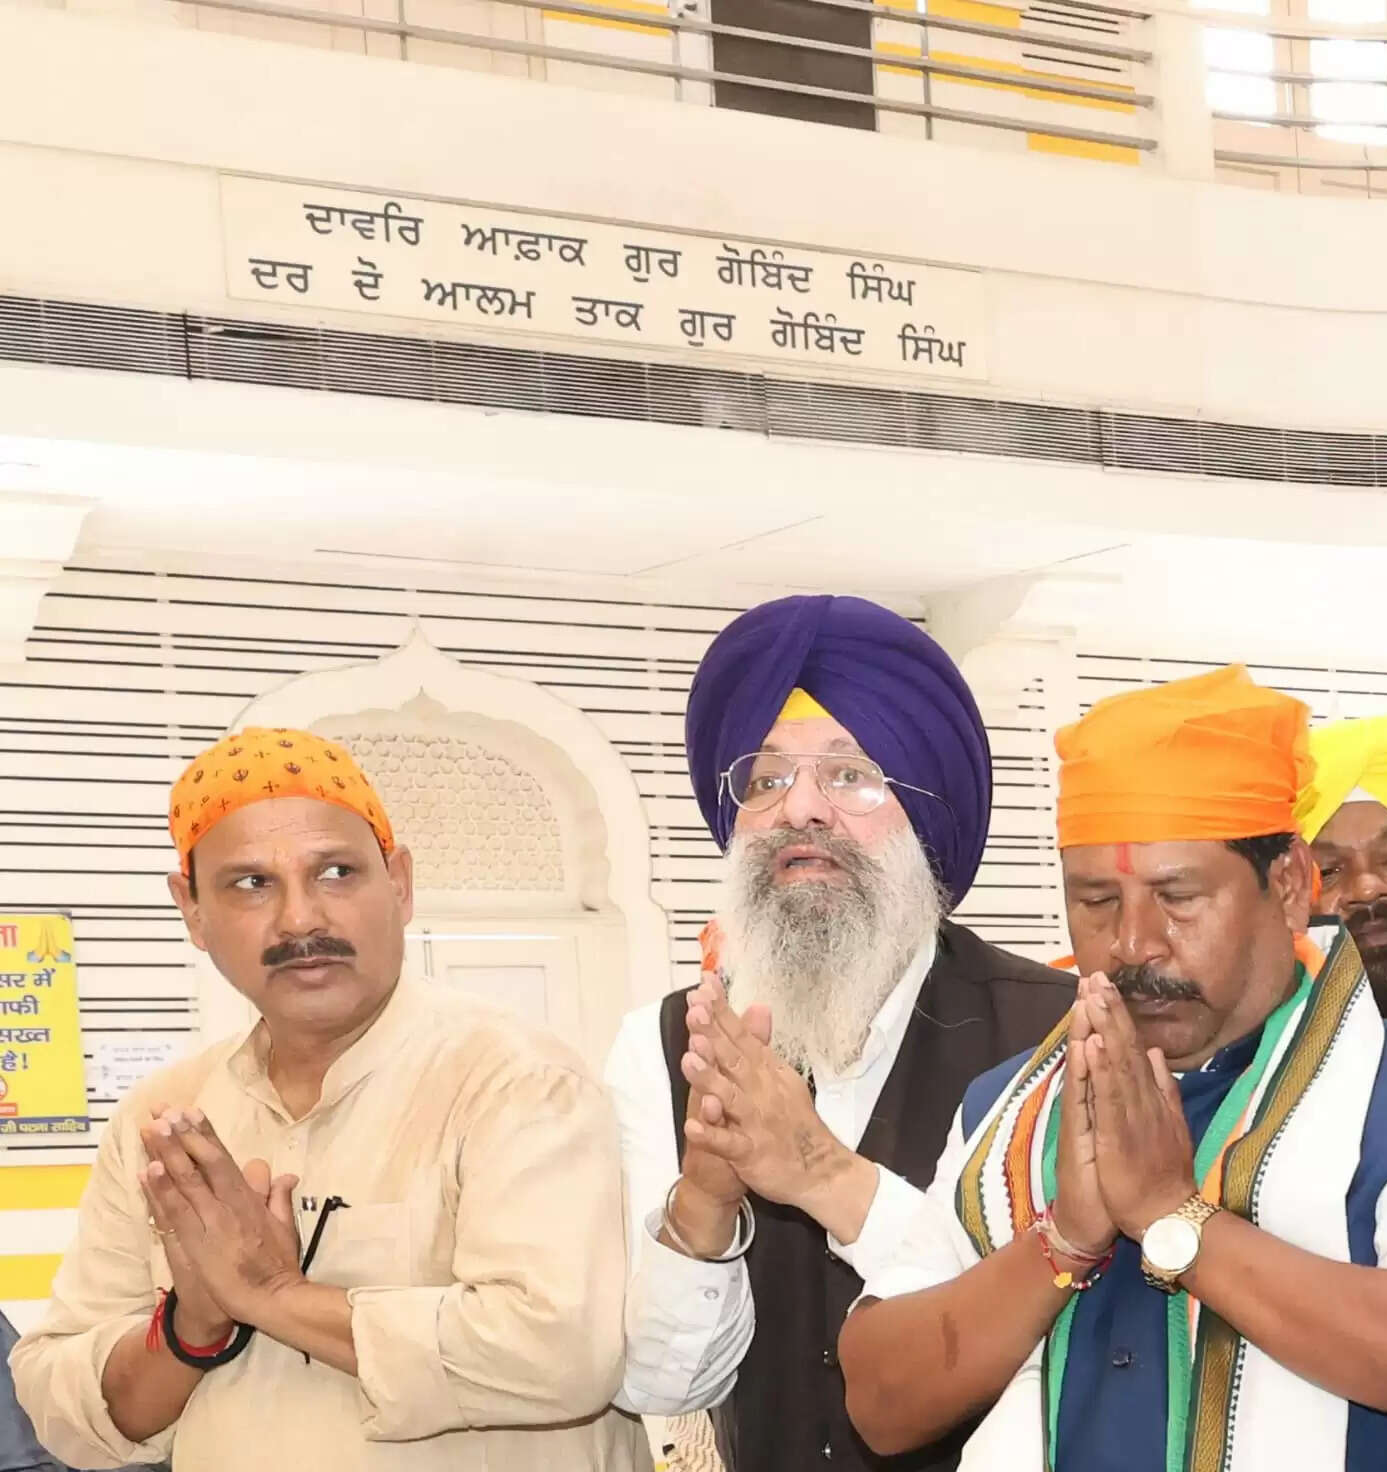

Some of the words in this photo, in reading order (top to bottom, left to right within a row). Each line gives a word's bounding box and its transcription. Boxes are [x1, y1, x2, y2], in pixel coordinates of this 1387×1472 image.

[302, 201, 425, 246] ਦਾਵਰਿ
[460, 223, 589, 267] ਆਫ਼ਾਕ
[622, 243, 682, 283] ਗੁਰ
[716, 243, 813, 293] ਗੋਬਿੰਦ
[845, 260, 916, 307] ਸਿੰਘ
[248, 257, 314, 294] ਦਰ
[351, 255, 384, 301] ਦੋ
[420, 278, 537, 320] ਆਲਮ
[571, 295, 645, 332] ਤਾਕ
[678, 308, 736, 348] ਗੁਰ
[769, 306, 866, 356] ਗੋਬਿੰਦ
[896, 322, 967, 368] ਸਿੰਘ
[32, 967, 56, 988] में
